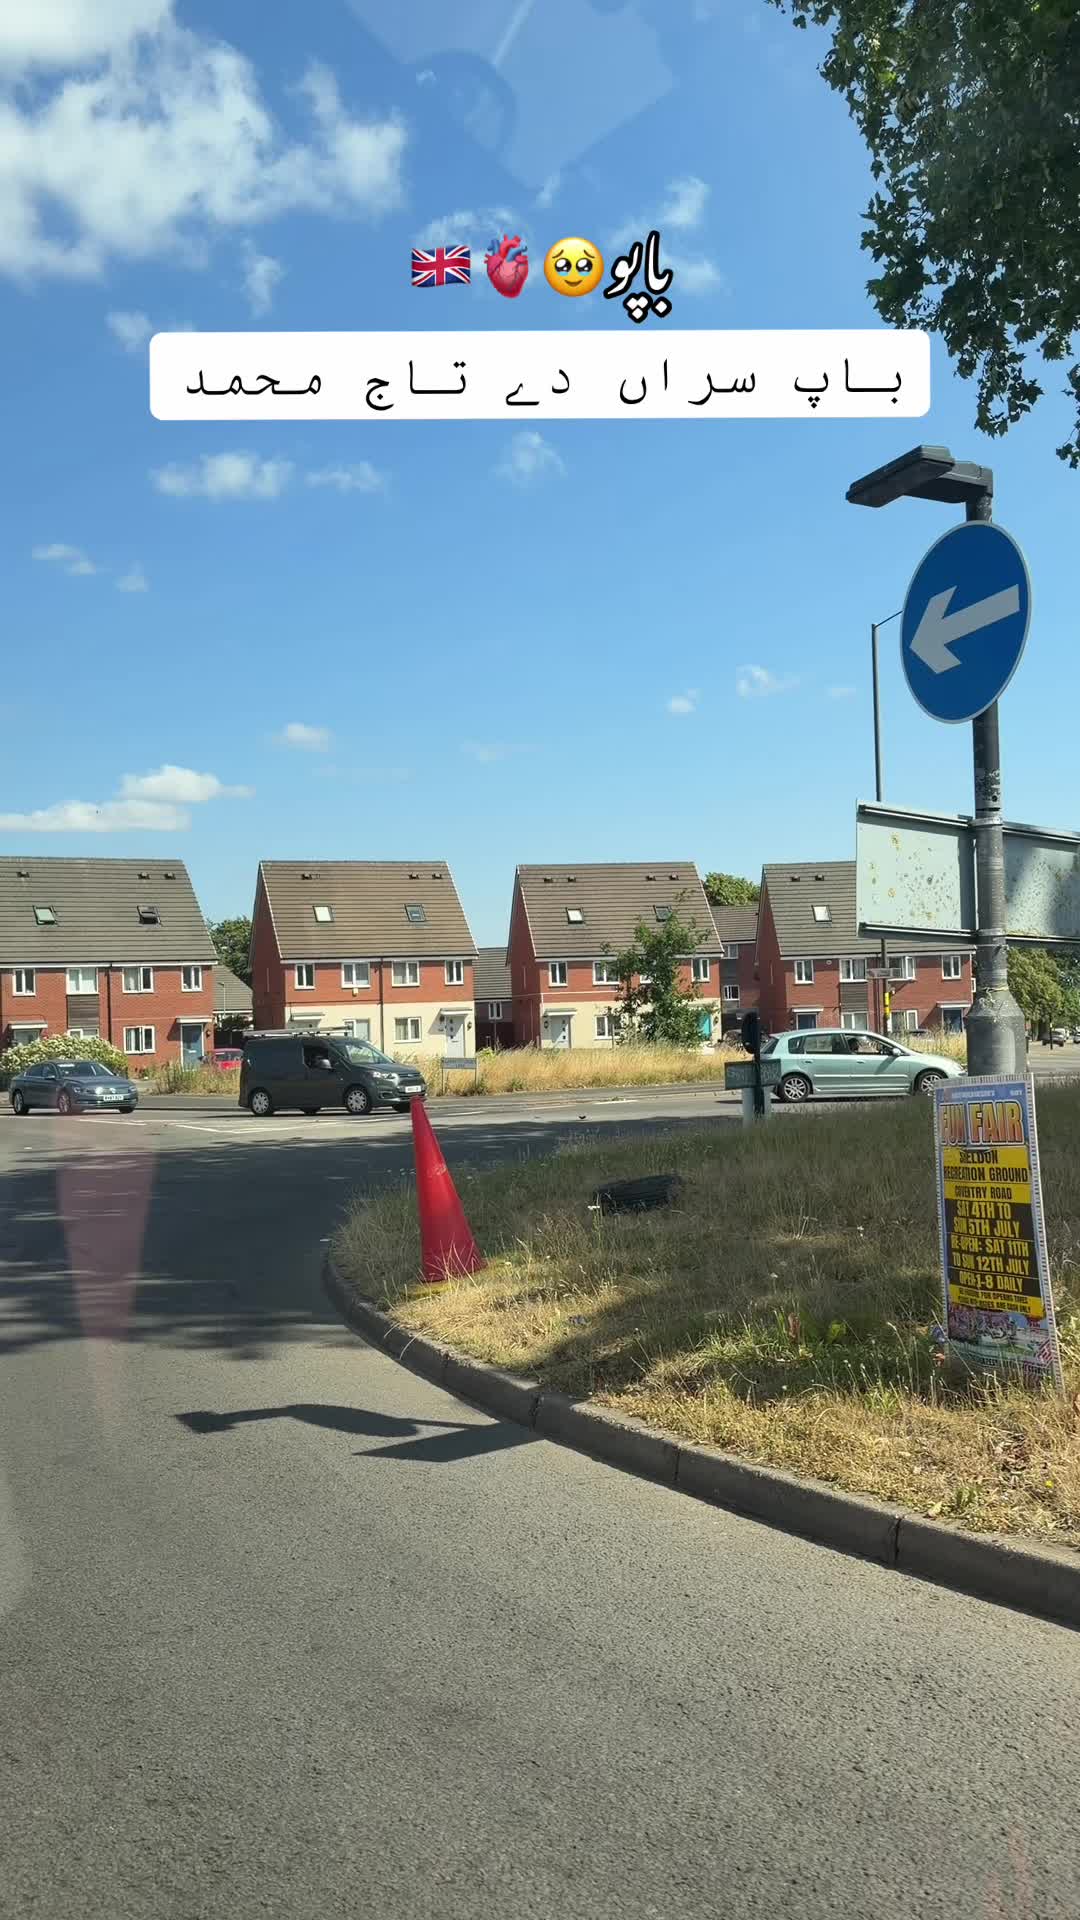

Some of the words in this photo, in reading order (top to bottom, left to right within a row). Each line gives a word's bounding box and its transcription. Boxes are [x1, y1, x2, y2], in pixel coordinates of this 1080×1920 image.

[939, 1102, 966, 1145] FUN
[968, 1099, 1024, 1145] FAIR
[989, 1167, 1028, 1182] GROUND
[955, 1185, 987, 1199] COVENTRY
[990, 1187, 1012, 1200] ROAD
[971, 1201, 996, 1218] 4TH
[997, 1202, 1012, 1219] TO
[968, 1218, 990, 1236] 5TH
[994, 1220, 1020, 1238] JULY
[984, 1238, 1005, 1254] SAT
[1007, 1240, 1029, 1257] 11TH
[976, 1255, 1004, 1273] 12TH
[1005, 1258, 1029, 1275] JULY
[996, 1275, 1023, 1292] DAILY
